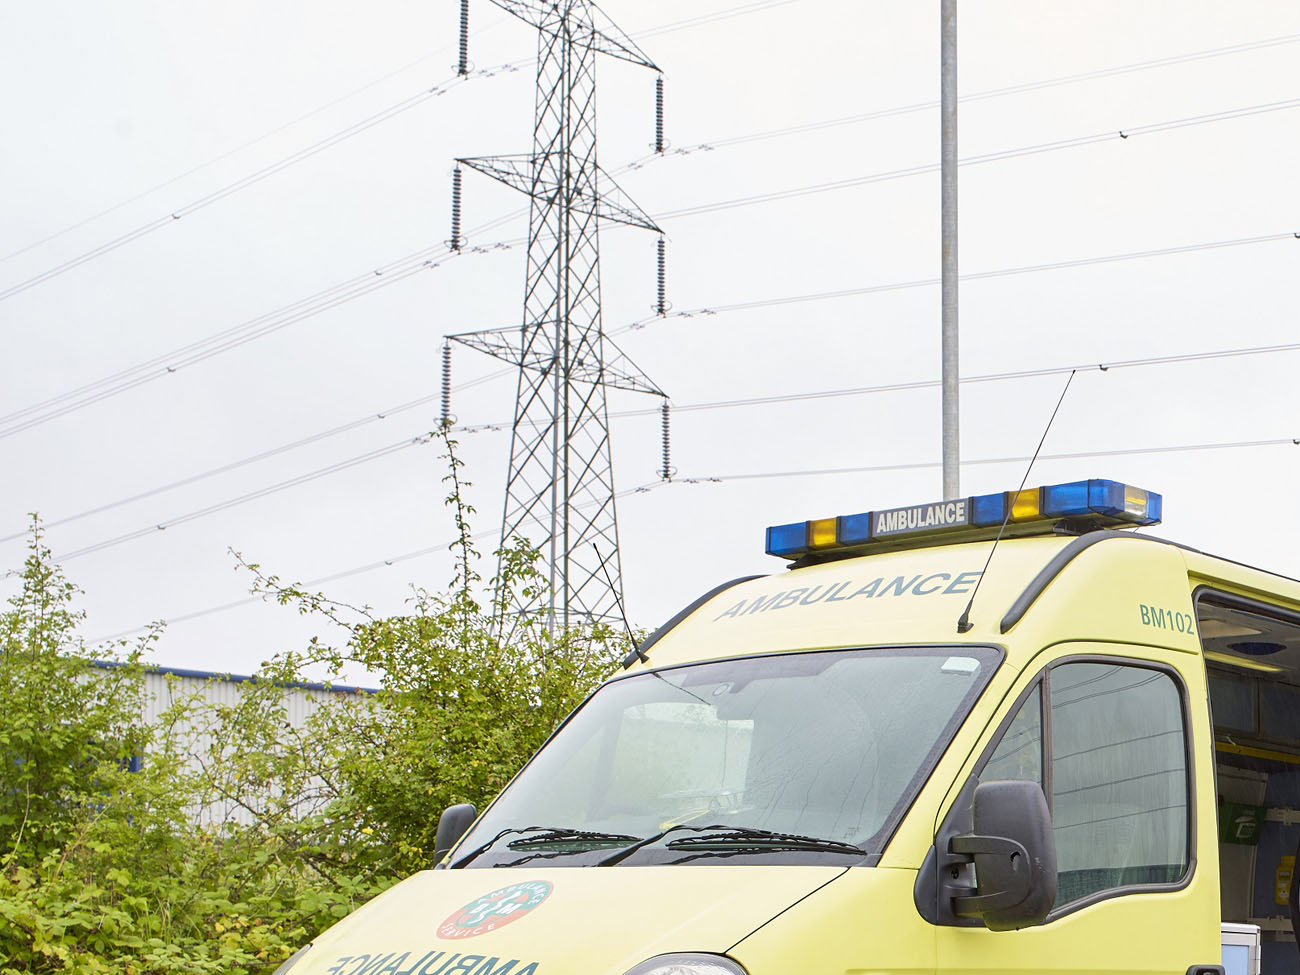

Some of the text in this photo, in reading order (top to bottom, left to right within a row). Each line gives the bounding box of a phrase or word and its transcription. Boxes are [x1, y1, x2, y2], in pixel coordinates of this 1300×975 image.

[876, 500, 965, 533] AMBULANCE
[713, 571, 983, 622] AMBULANCE
[1140, 604, 1195, 635] BM102
